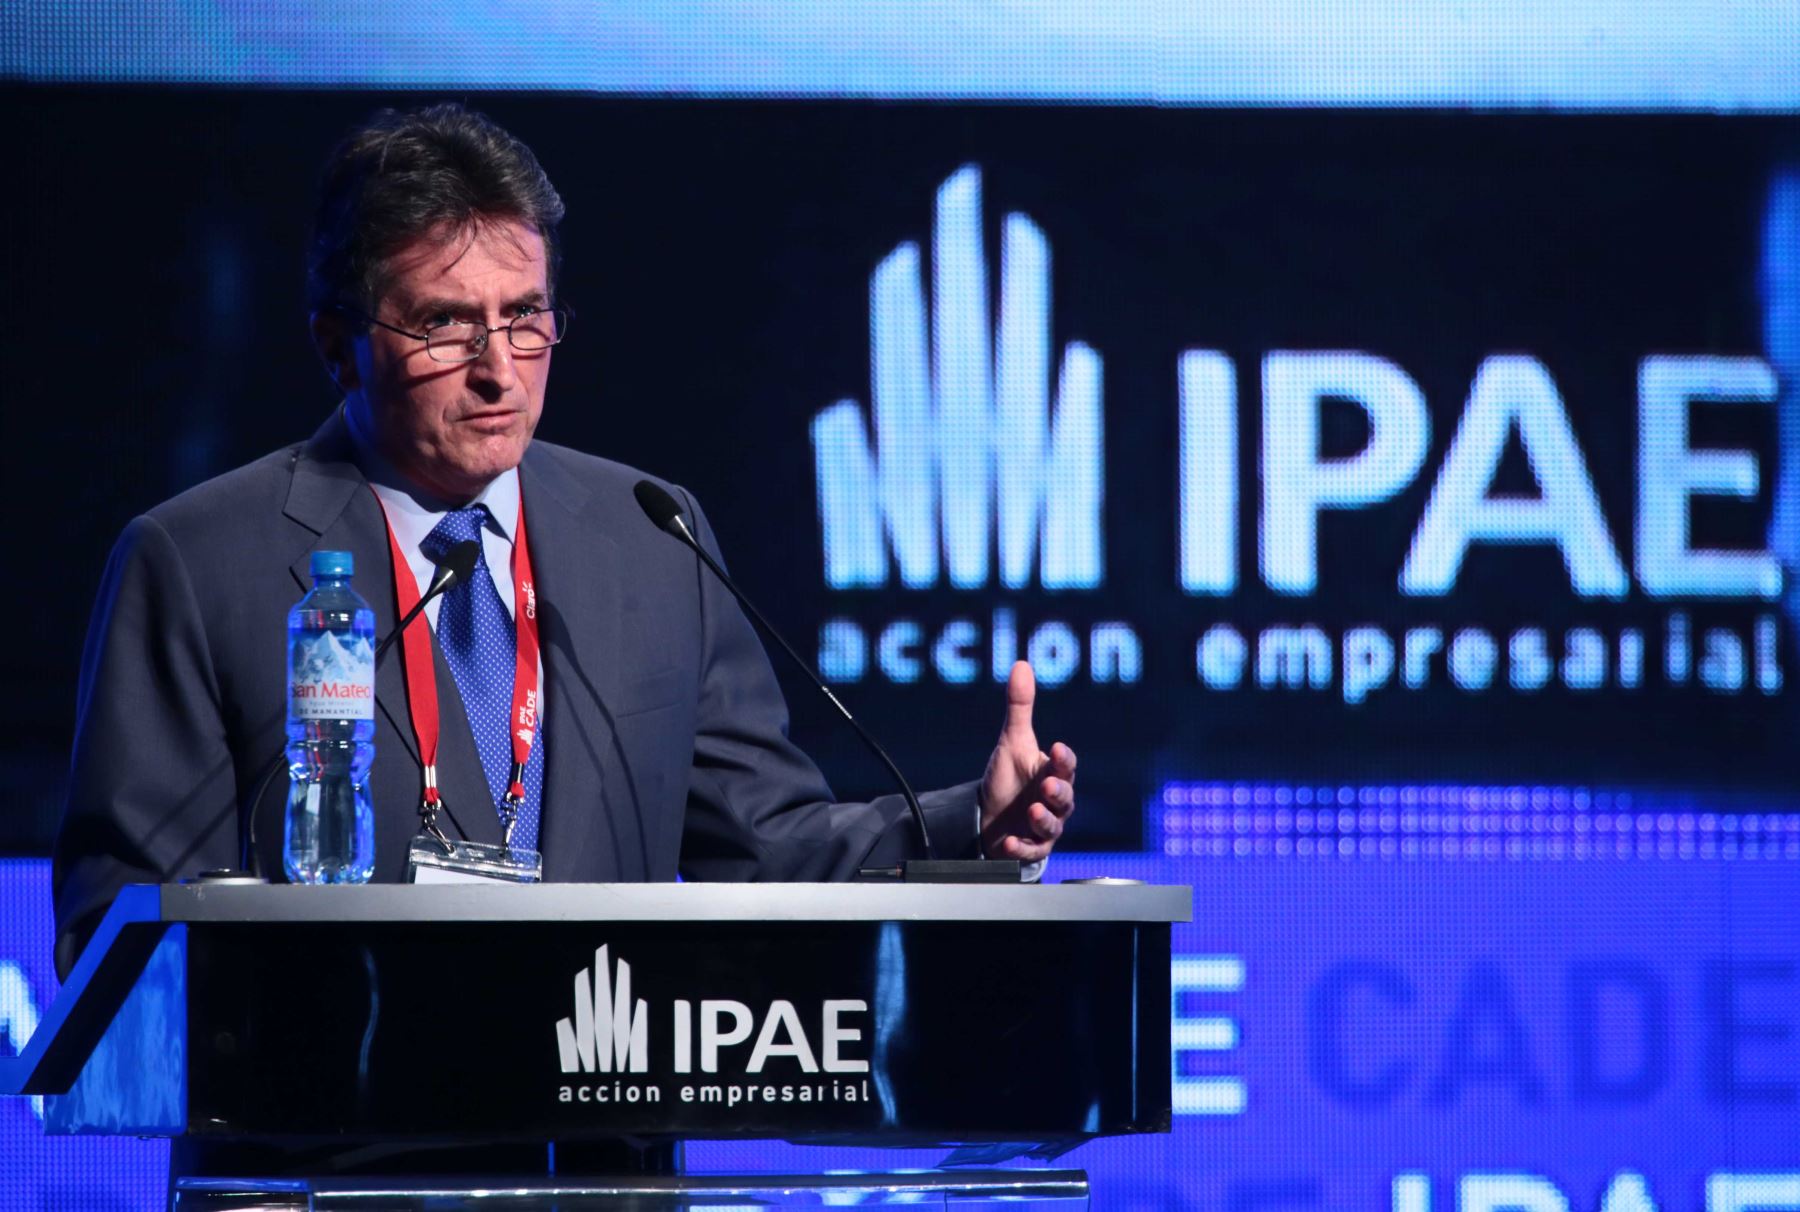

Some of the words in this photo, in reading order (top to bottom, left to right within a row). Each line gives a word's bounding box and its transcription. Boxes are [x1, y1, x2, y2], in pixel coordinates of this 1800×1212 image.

[1176, 350, 1782, 599] IPAE
[526, 588, 536, 619] Claro
[818, 606, 1143, 688] accion
[1197, 610, 1783, 703] empresarial
[526, 689, 536, 727] CADE
[674, 999, 869, 1073] IPAE
[1305, 957, 1798, 1111] CADE
[558, 1081, 661, 1102] accion
[680, 1080, 869, 1107] empresarial
